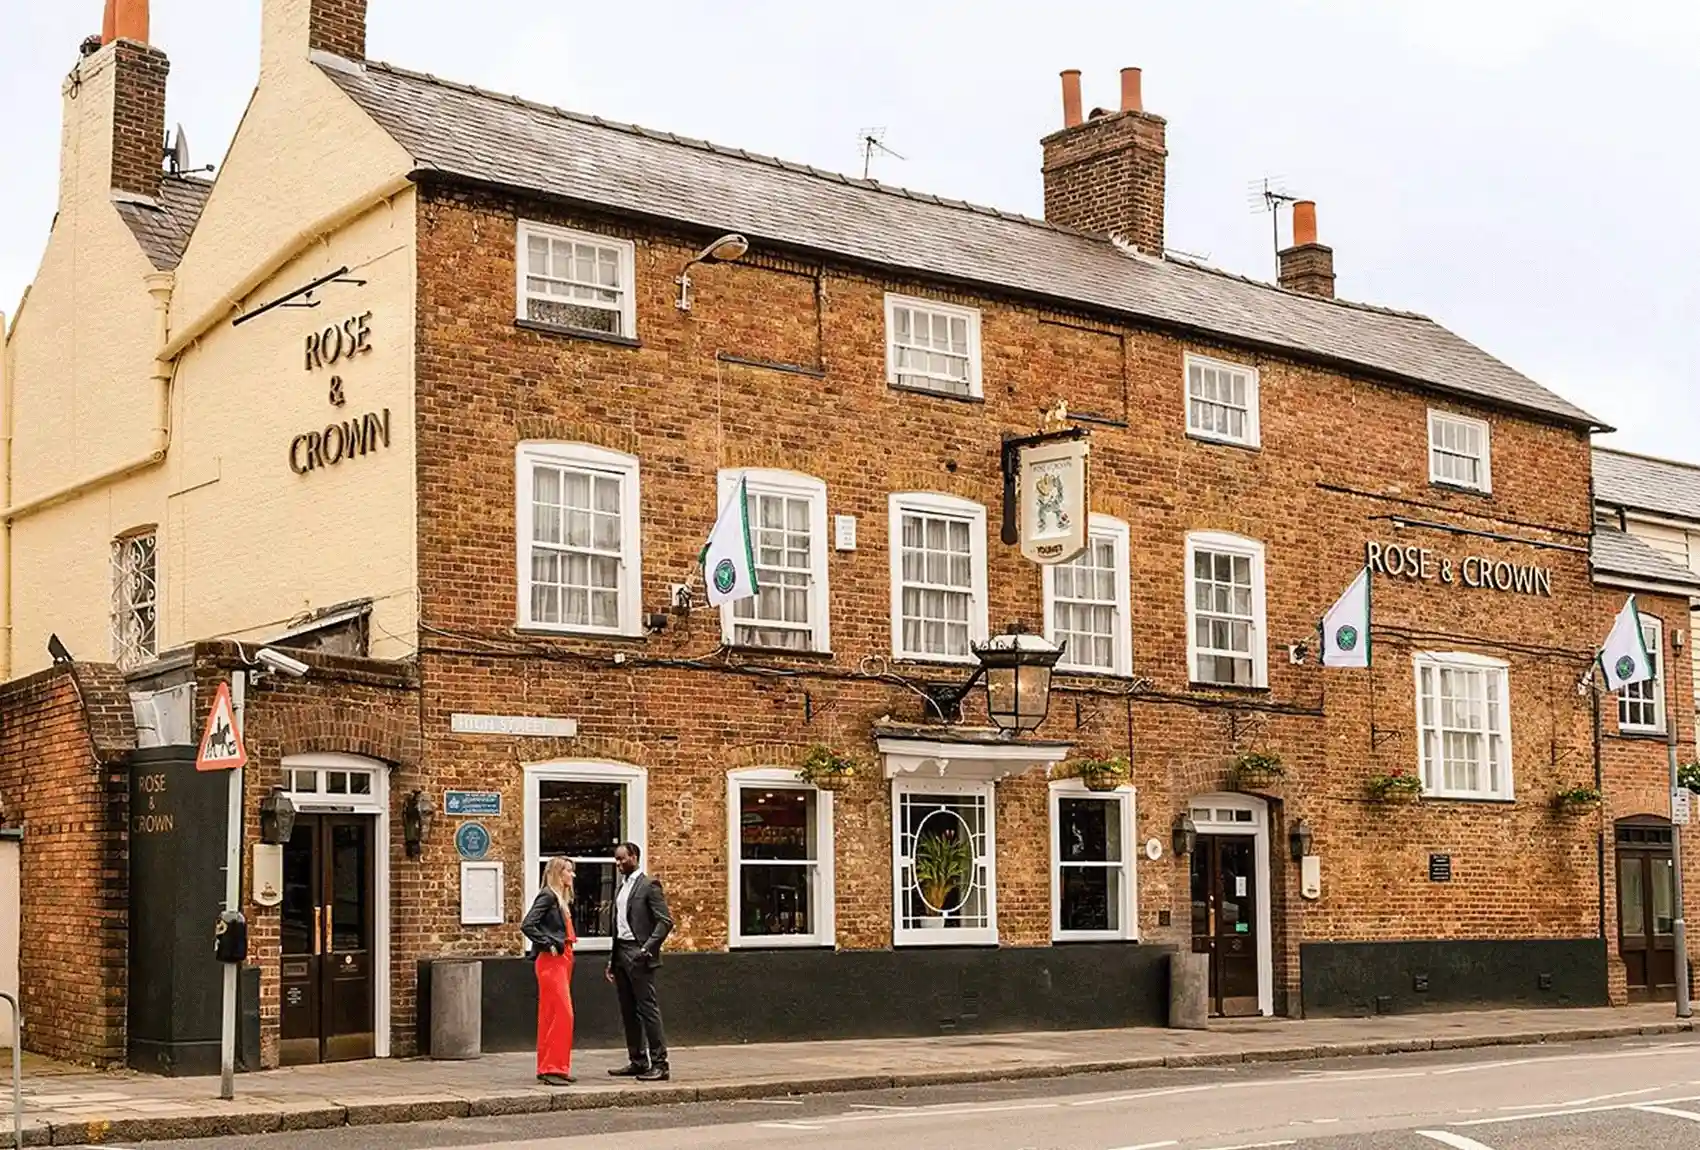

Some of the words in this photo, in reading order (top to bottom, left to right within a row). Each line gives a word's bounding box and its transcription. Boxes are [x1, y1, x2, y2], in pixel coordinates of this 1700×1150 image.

[304, 311, 372, 370] ROSE
[328, 375, 345, 406] &
[288, 408, 390, 475] CROWN
[1366, 541, 1434, 579] ROSE
[1441, 558, 1453, 582] &
[1462, 556, 1552, 596] CROWN
[459, 718, 495, 731] HIGH
[139, 773, 167, 793] ROSE
[132, 814, 173, 832] CROWN
